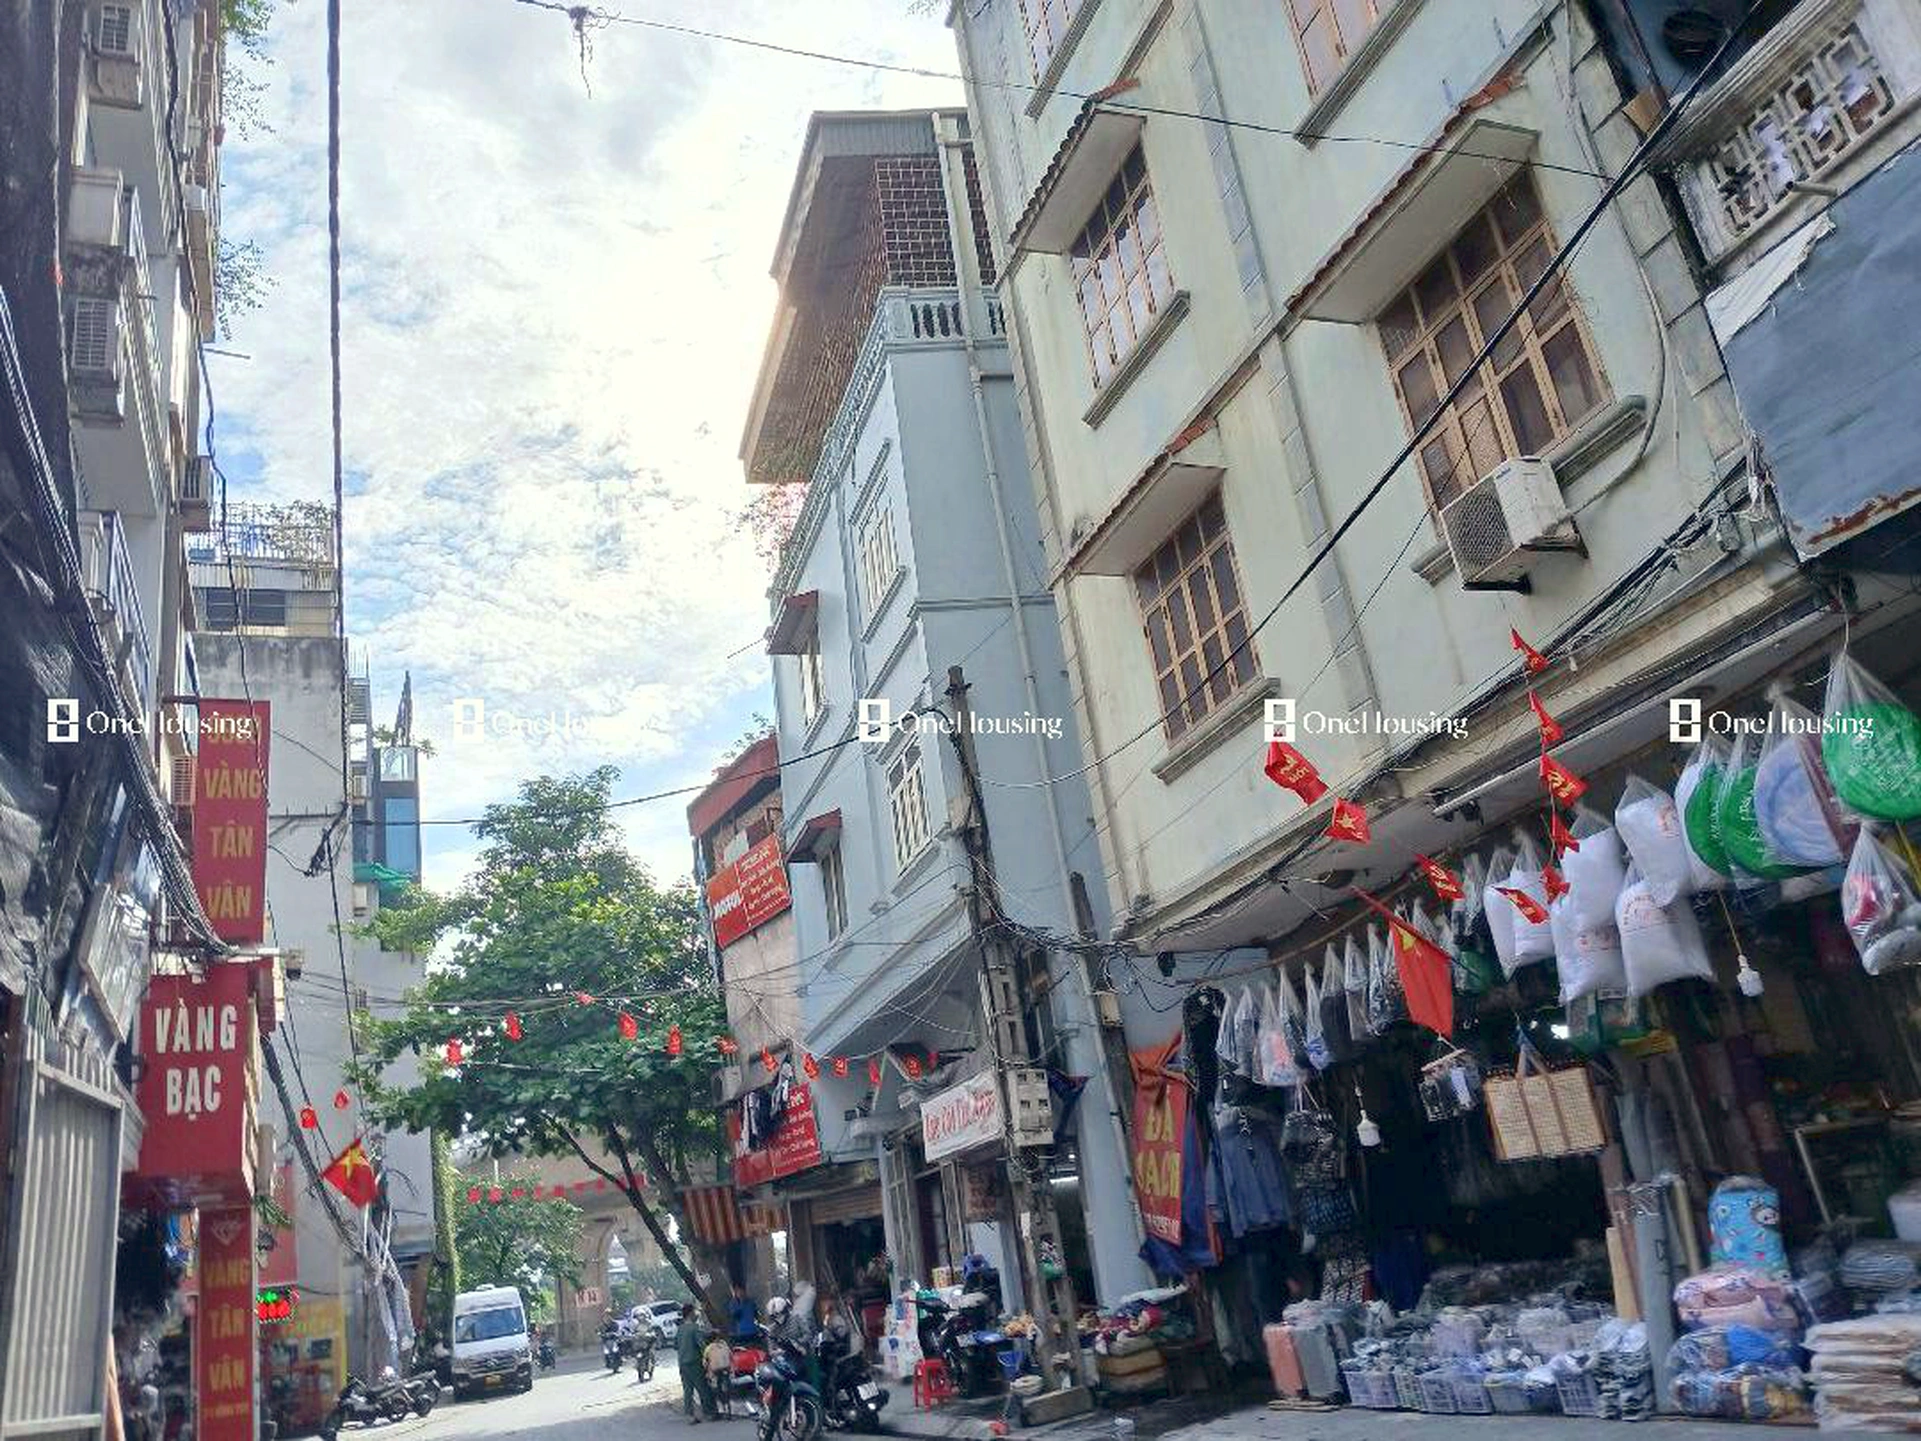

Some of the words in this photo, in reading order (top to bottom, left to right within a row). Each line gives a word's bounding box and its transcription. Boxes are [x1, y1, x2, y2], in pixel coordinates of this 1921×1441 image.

[203, 760, 263, 799] VÀNG
[209, 818, 254, 859] TÂN
[155, 997, 237, 1054] VÀNG
[166, 1066, 222, 1121] BẠC
